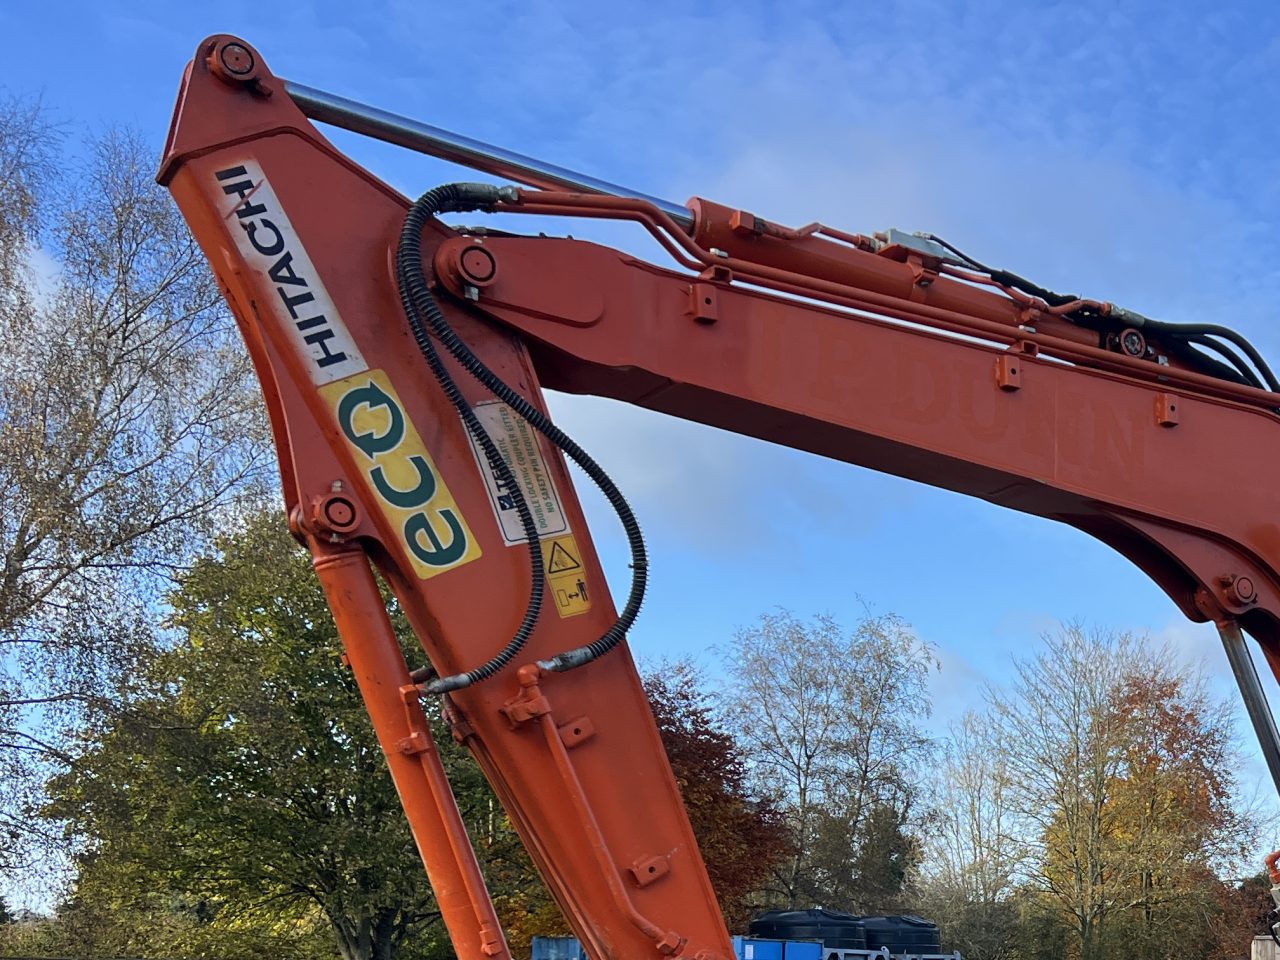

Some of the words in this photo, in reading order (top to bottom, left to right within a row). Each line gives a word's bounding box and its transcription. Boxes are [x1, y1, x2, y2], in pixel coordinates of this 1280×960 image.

[215, 165, 348, 368] HITACHI
[508, 433, 525, 466] COUPLER
[528, 457, 540, 472] PIN
[519, 466, 537, 499] LOCKING
[534, 472, 550, 501] SAFETY
[544, 500, 554, 513] NO
